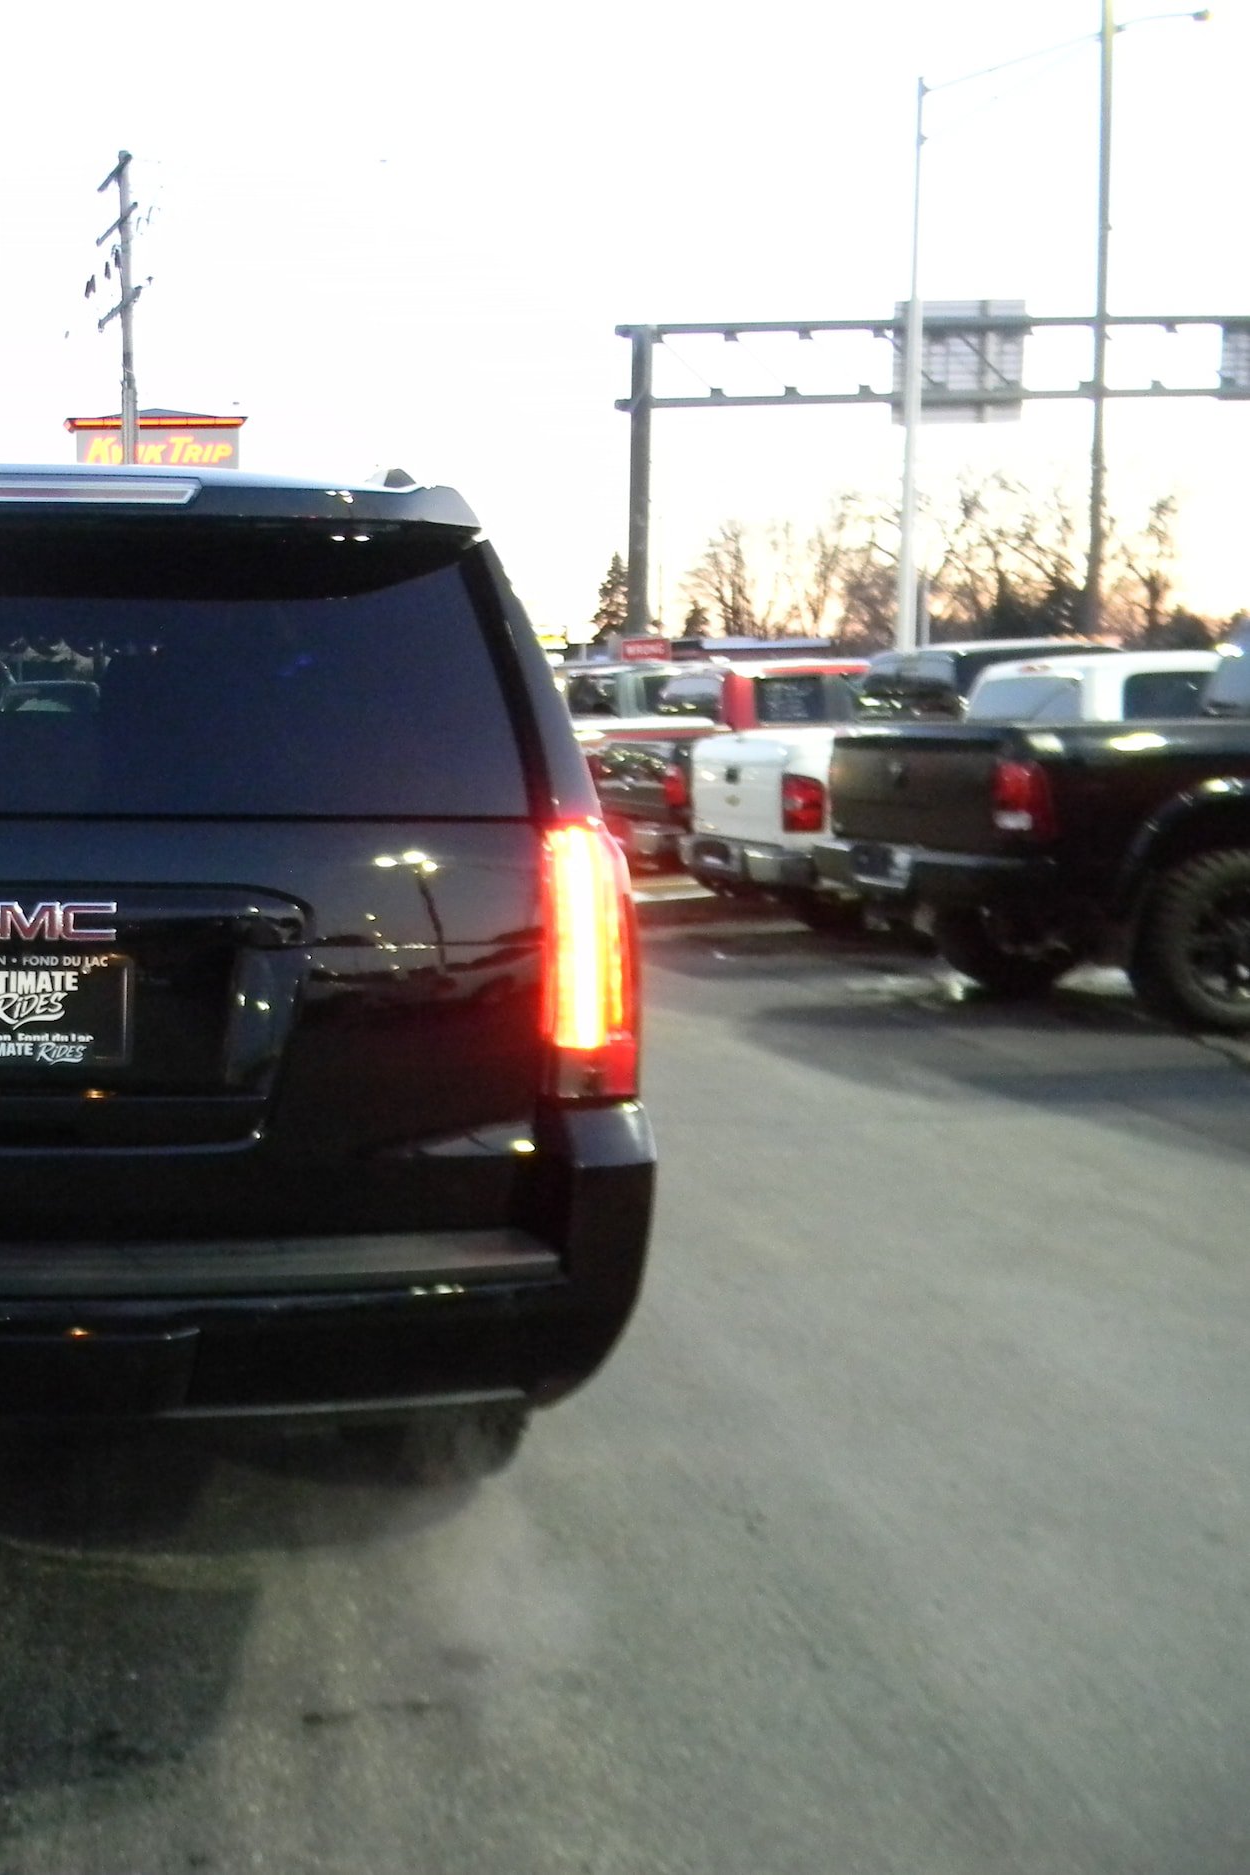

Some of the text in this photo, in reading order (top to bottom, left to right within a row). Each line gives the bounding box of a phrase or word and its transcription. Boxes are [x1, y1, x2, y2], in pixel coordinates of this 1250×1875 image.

[163, 436, 234, 464] TRIP
[22, 955, 59, 967] FOND
[62, 956, 82, 967] DU
[84, 956, 109, 968] LAC
